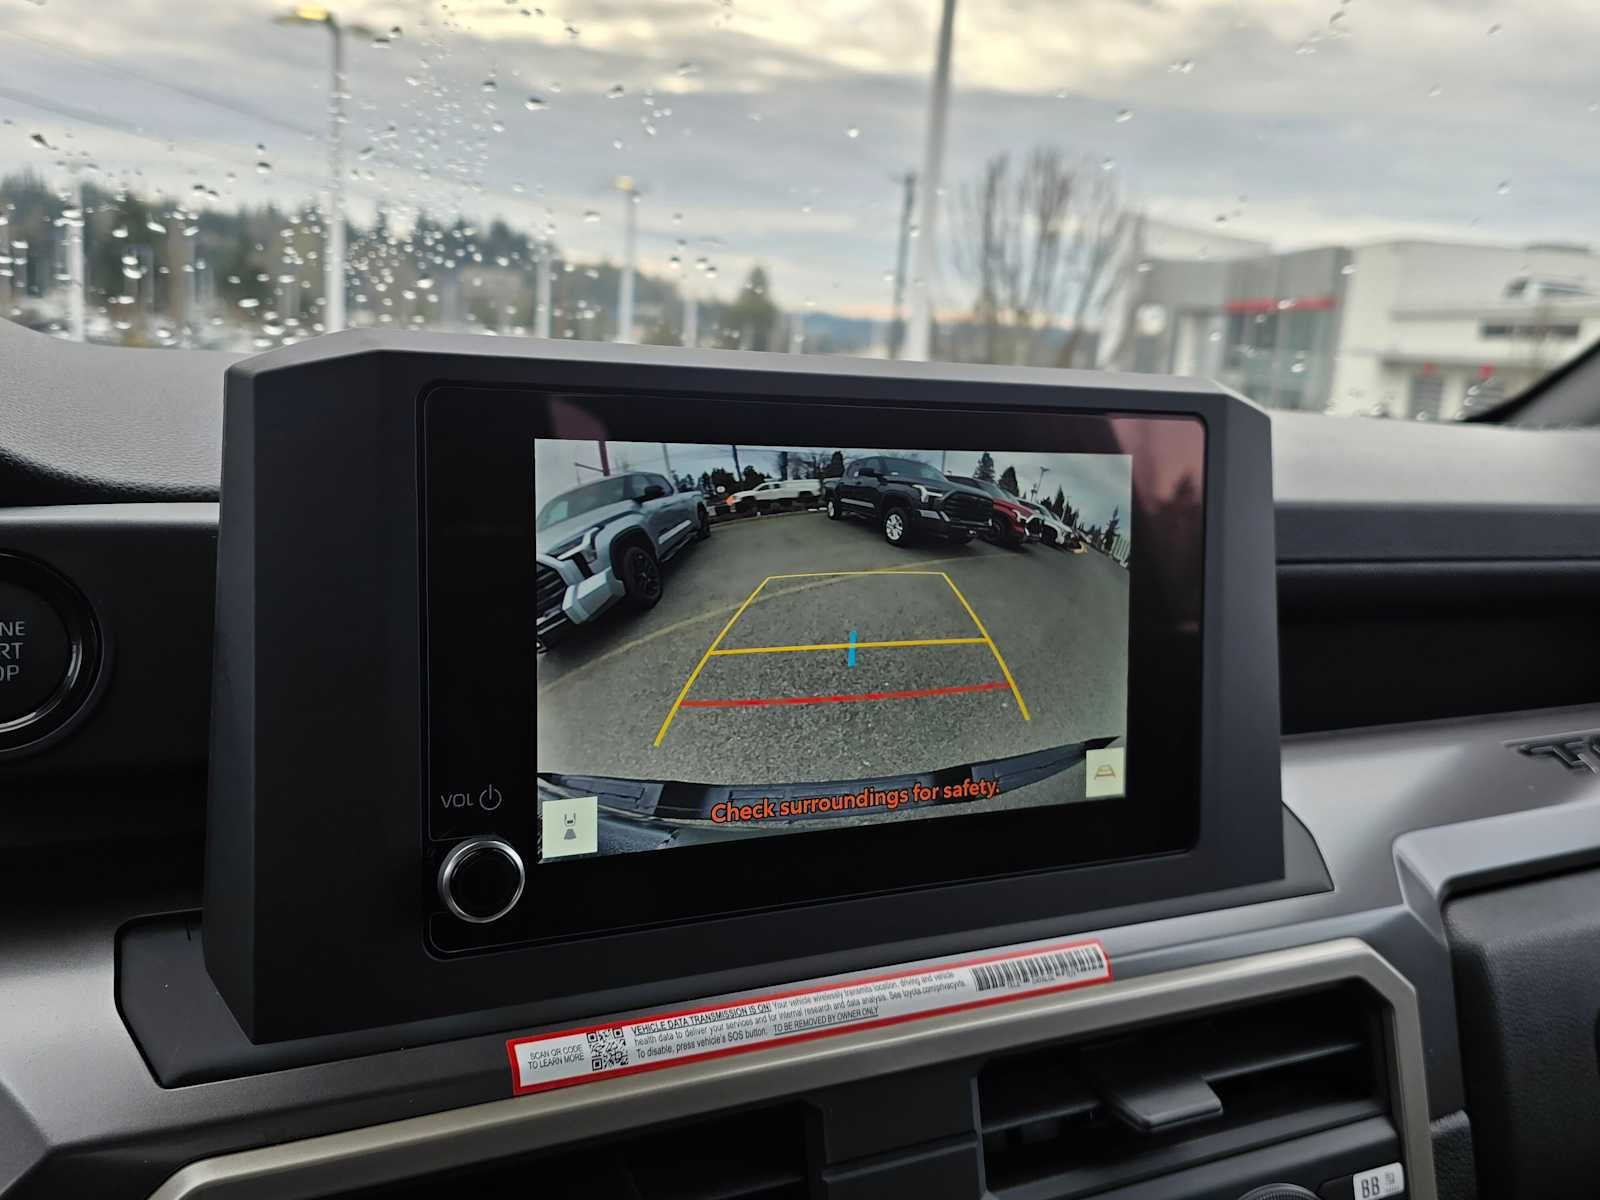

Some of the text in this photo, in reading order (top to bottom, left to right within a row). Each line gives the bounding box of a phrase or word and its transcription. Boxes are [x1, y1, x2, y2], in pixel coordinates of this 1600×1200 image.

[440, 793, 474, 809] VOL
[710, 777, 1000, 823] Check surroundings for safety.
[631, 1022, 666, 1035] VEHICLE
[668, 1018, 686, 1030] DATA
[688, 1007, 747, 1025] TRANSMISSION
[749, 1006, 757, 1014] IS
[634, 1034, 657, 1046] health
[658, 1032, 674, 1043] data
[675, 1030, 683, 1039] to
[685, 1027, 708, 1038] deliver
[709, 1024, 724, 1035] your
[755, 1014, 768, 1024] and
[768, 1012, 777, 1022] for
[778, 1008, 803, 1020] internal
[805, 1003, 833, 1016] research
[834, 1001, 846, 1010] and
[846, 998, 861, 1008] data
[636, 1048, 645, 1059] To
[646, 1044, 675, 1057] disable,
[676, 1042, 696, 1054] press
[697, 1035, 726, 1048] vehicle's
[727, 1031, 744, 1042] SOS
[773, 1024, 782, 1034] TO
[784, 1022, 793, 1032] BE
[794, 1015, 827, 1030] REMOVED
[828, 1014, 836, 1023] BY
[836, 1009, 862, 1021] OWNER
[862, 1005, 879, 1016] ONLY
[528, 1052, 585, 1070] TO LEARN MORE
[530, 1050, 550, 1060] SCAN
[562, 1044, 584, 1055] CODE
